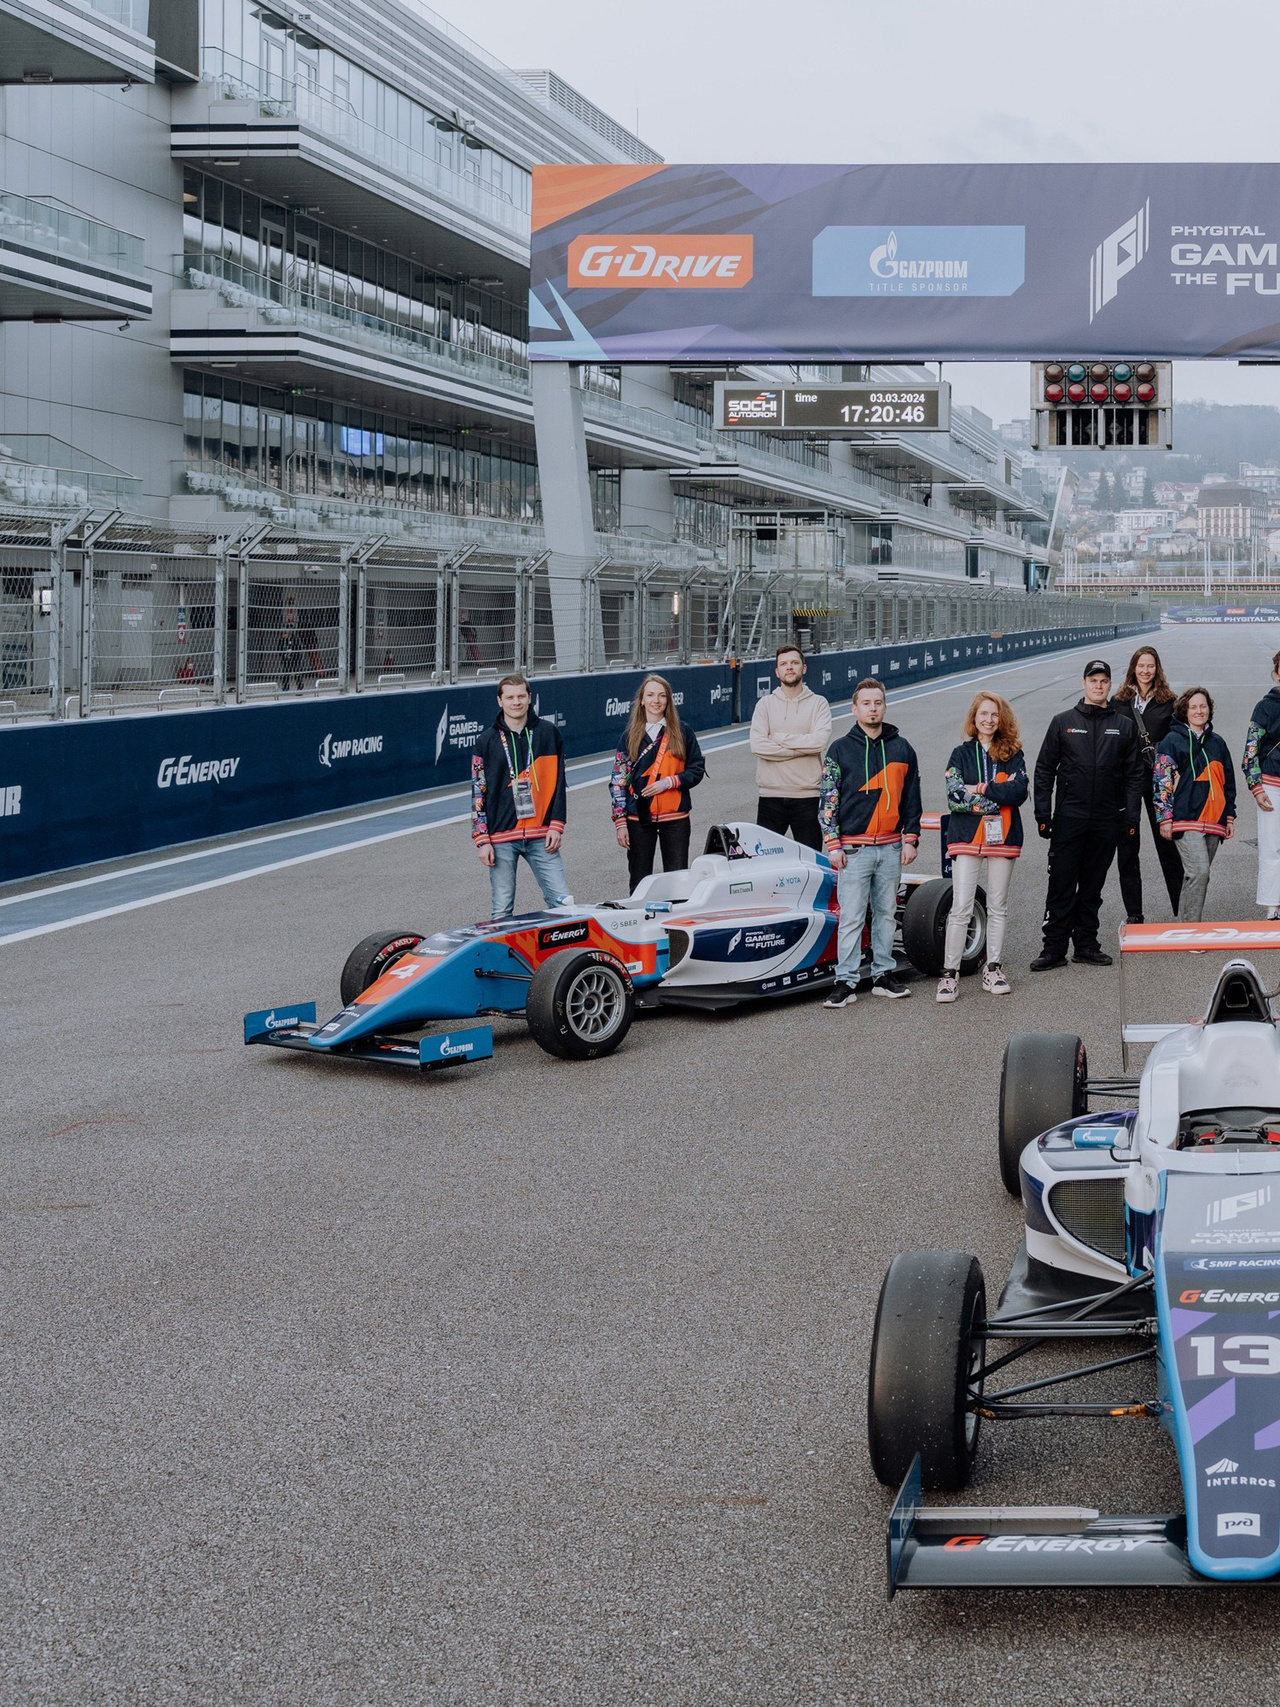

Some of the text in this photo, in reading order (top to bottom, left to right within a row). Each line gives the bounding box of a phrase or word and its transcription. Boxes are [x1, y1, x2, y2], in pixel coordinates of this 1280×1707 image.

[1170, 225, 1266, 236] PHYGITAL
[898, 260, 968, 278] GAZPROM
[1170, 273, 1218, 285] THE
[869, 282, 968, 292] TITLE SPONSOR
[794, 392, 818, 403] time
[869, 393, 926, 403] 03.03.2024
[728, 400, 777, 411] SOCHI
[840, 405, 925, 423] 17:20:46
[449, 721, 478, 736] GAMES
[331, 735, 383, 759] SMP RACING
[157, 755, 240, 789] G-ENERGY
[619, 919, 638, 928] SBER
[542, 927, 586, 944] G-ENERGY
[745, 934, 776, 943] GAMES
[755, 939, 786, 949] FUTURE
[388, 964, 420, 980] 4
[1208, 1259, 1237, 1268] SMP
[1206, 1476, 1276, 1488] INTERROS
[943, 1535, 1150, 1555] G-ENERGY
